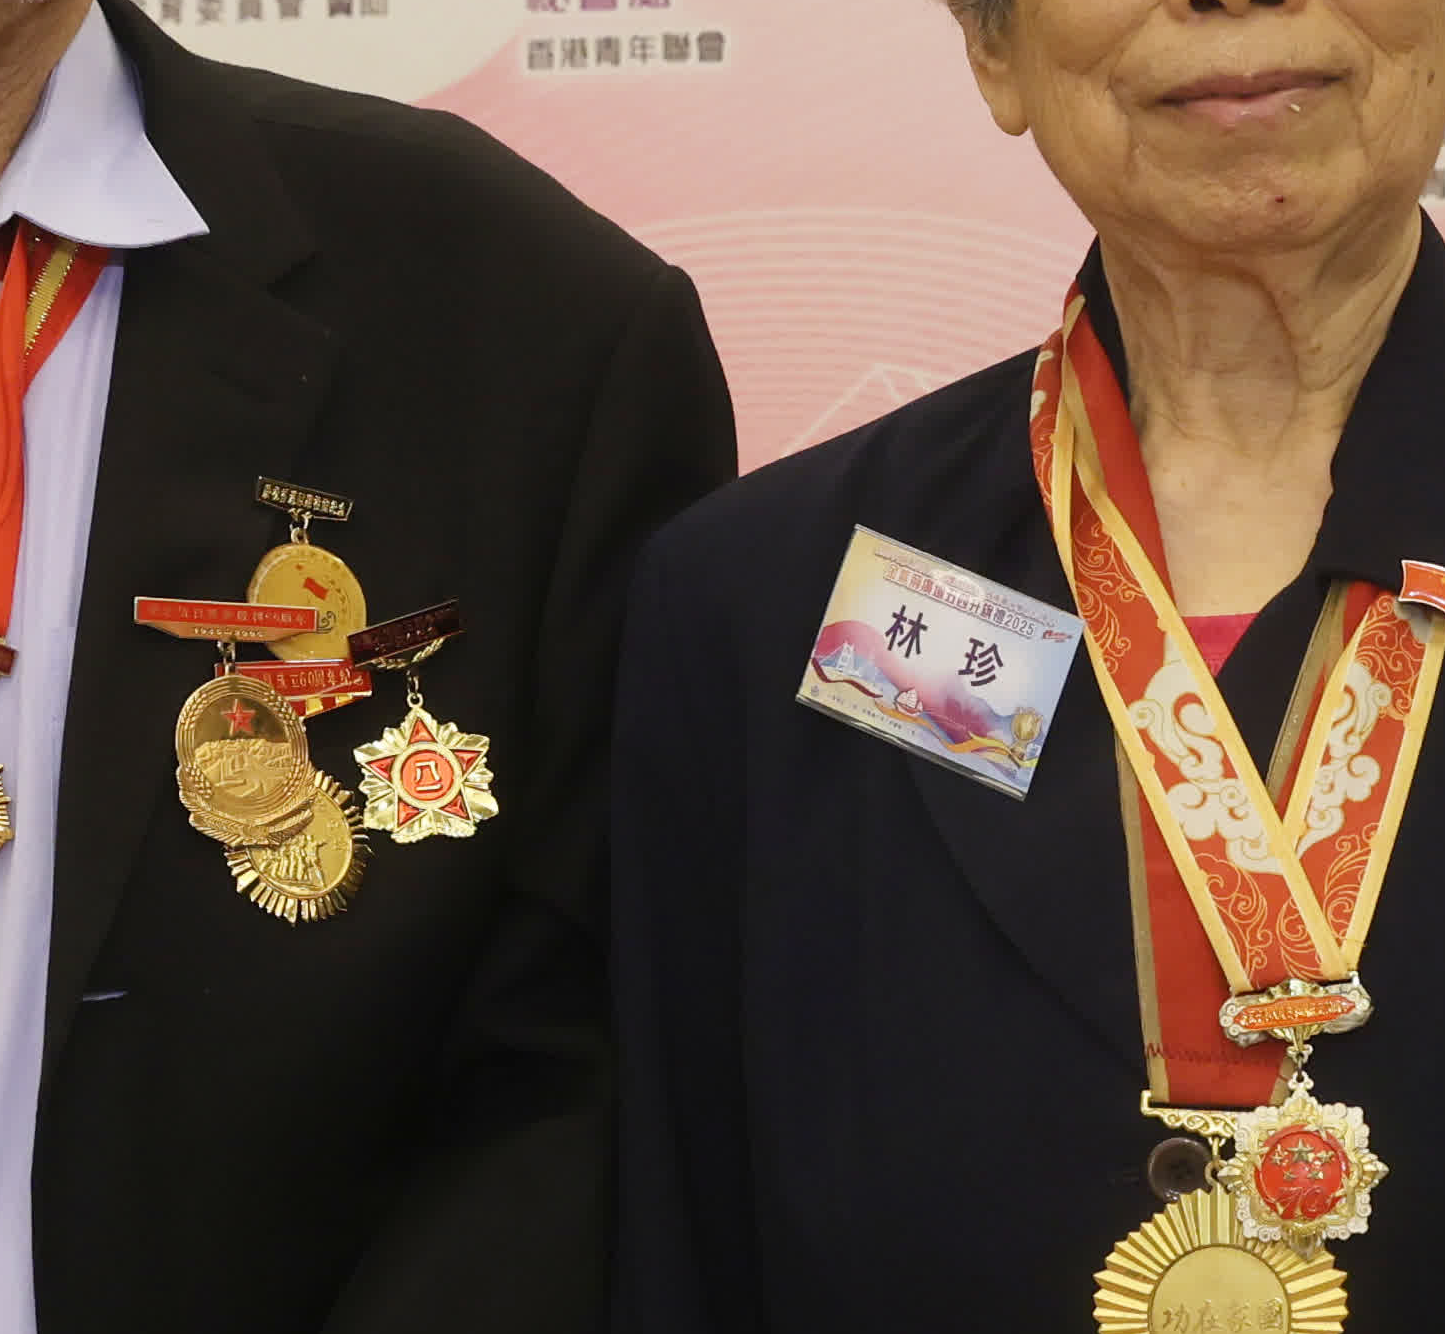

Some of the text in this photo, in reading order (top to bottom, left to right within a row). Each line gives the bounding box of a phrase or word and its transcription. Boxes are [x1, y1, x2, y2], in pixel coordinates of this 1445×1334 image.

[526, 30, 726, 71] 香港青年聯會
[884, 604, 1004, 687] 林珍
